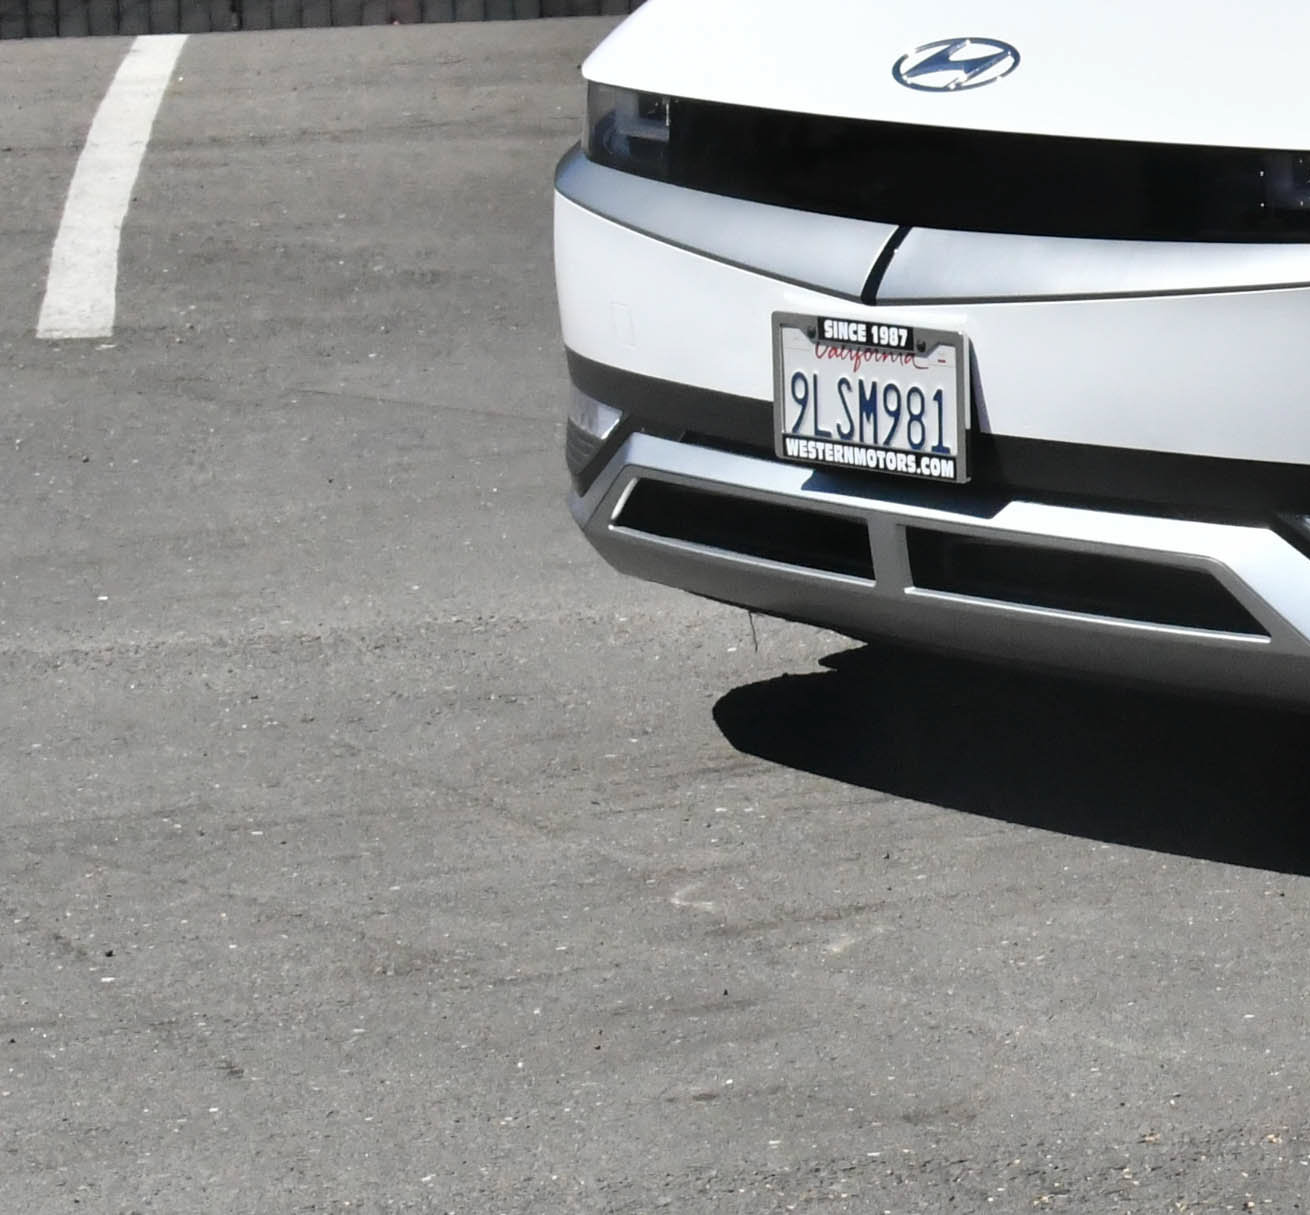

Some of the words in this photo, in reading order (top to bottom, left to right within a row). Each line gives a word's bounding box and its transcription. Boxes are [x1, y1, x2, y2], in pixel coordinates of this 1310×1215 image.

[824, 319, 867, 343] SINCE
[871, 324, 908, 347] 1987
[790, 371, 951, 454] 9LSM981
[786, 437, 955, 479] WESTERNMOTORS.COM
